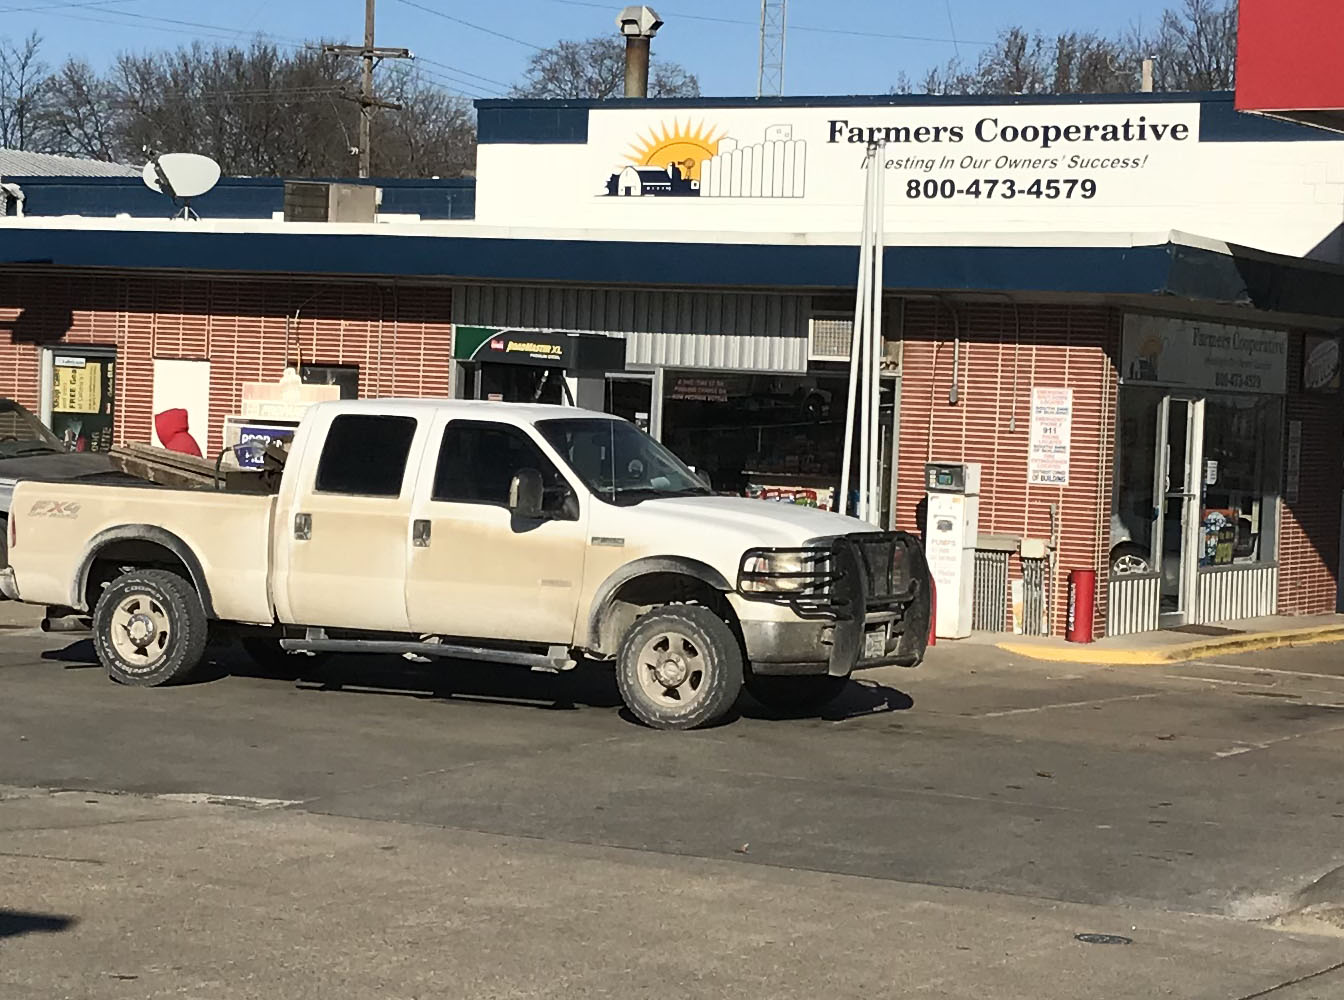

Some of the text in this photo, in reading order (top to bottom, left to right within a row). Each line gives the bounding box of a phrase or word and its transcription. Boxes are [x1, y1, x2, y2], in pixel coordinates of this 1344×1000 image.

[826, 116, 1190, 149] Farmers Cooperative
[939, 156, 956, 170] In
[959, 156, 990, 171] Our
[1067, 153, 1150, 170] Success!
[905, 178, 1098, 200] 800-473-4579
[29, 499, 81, 514] FX4
